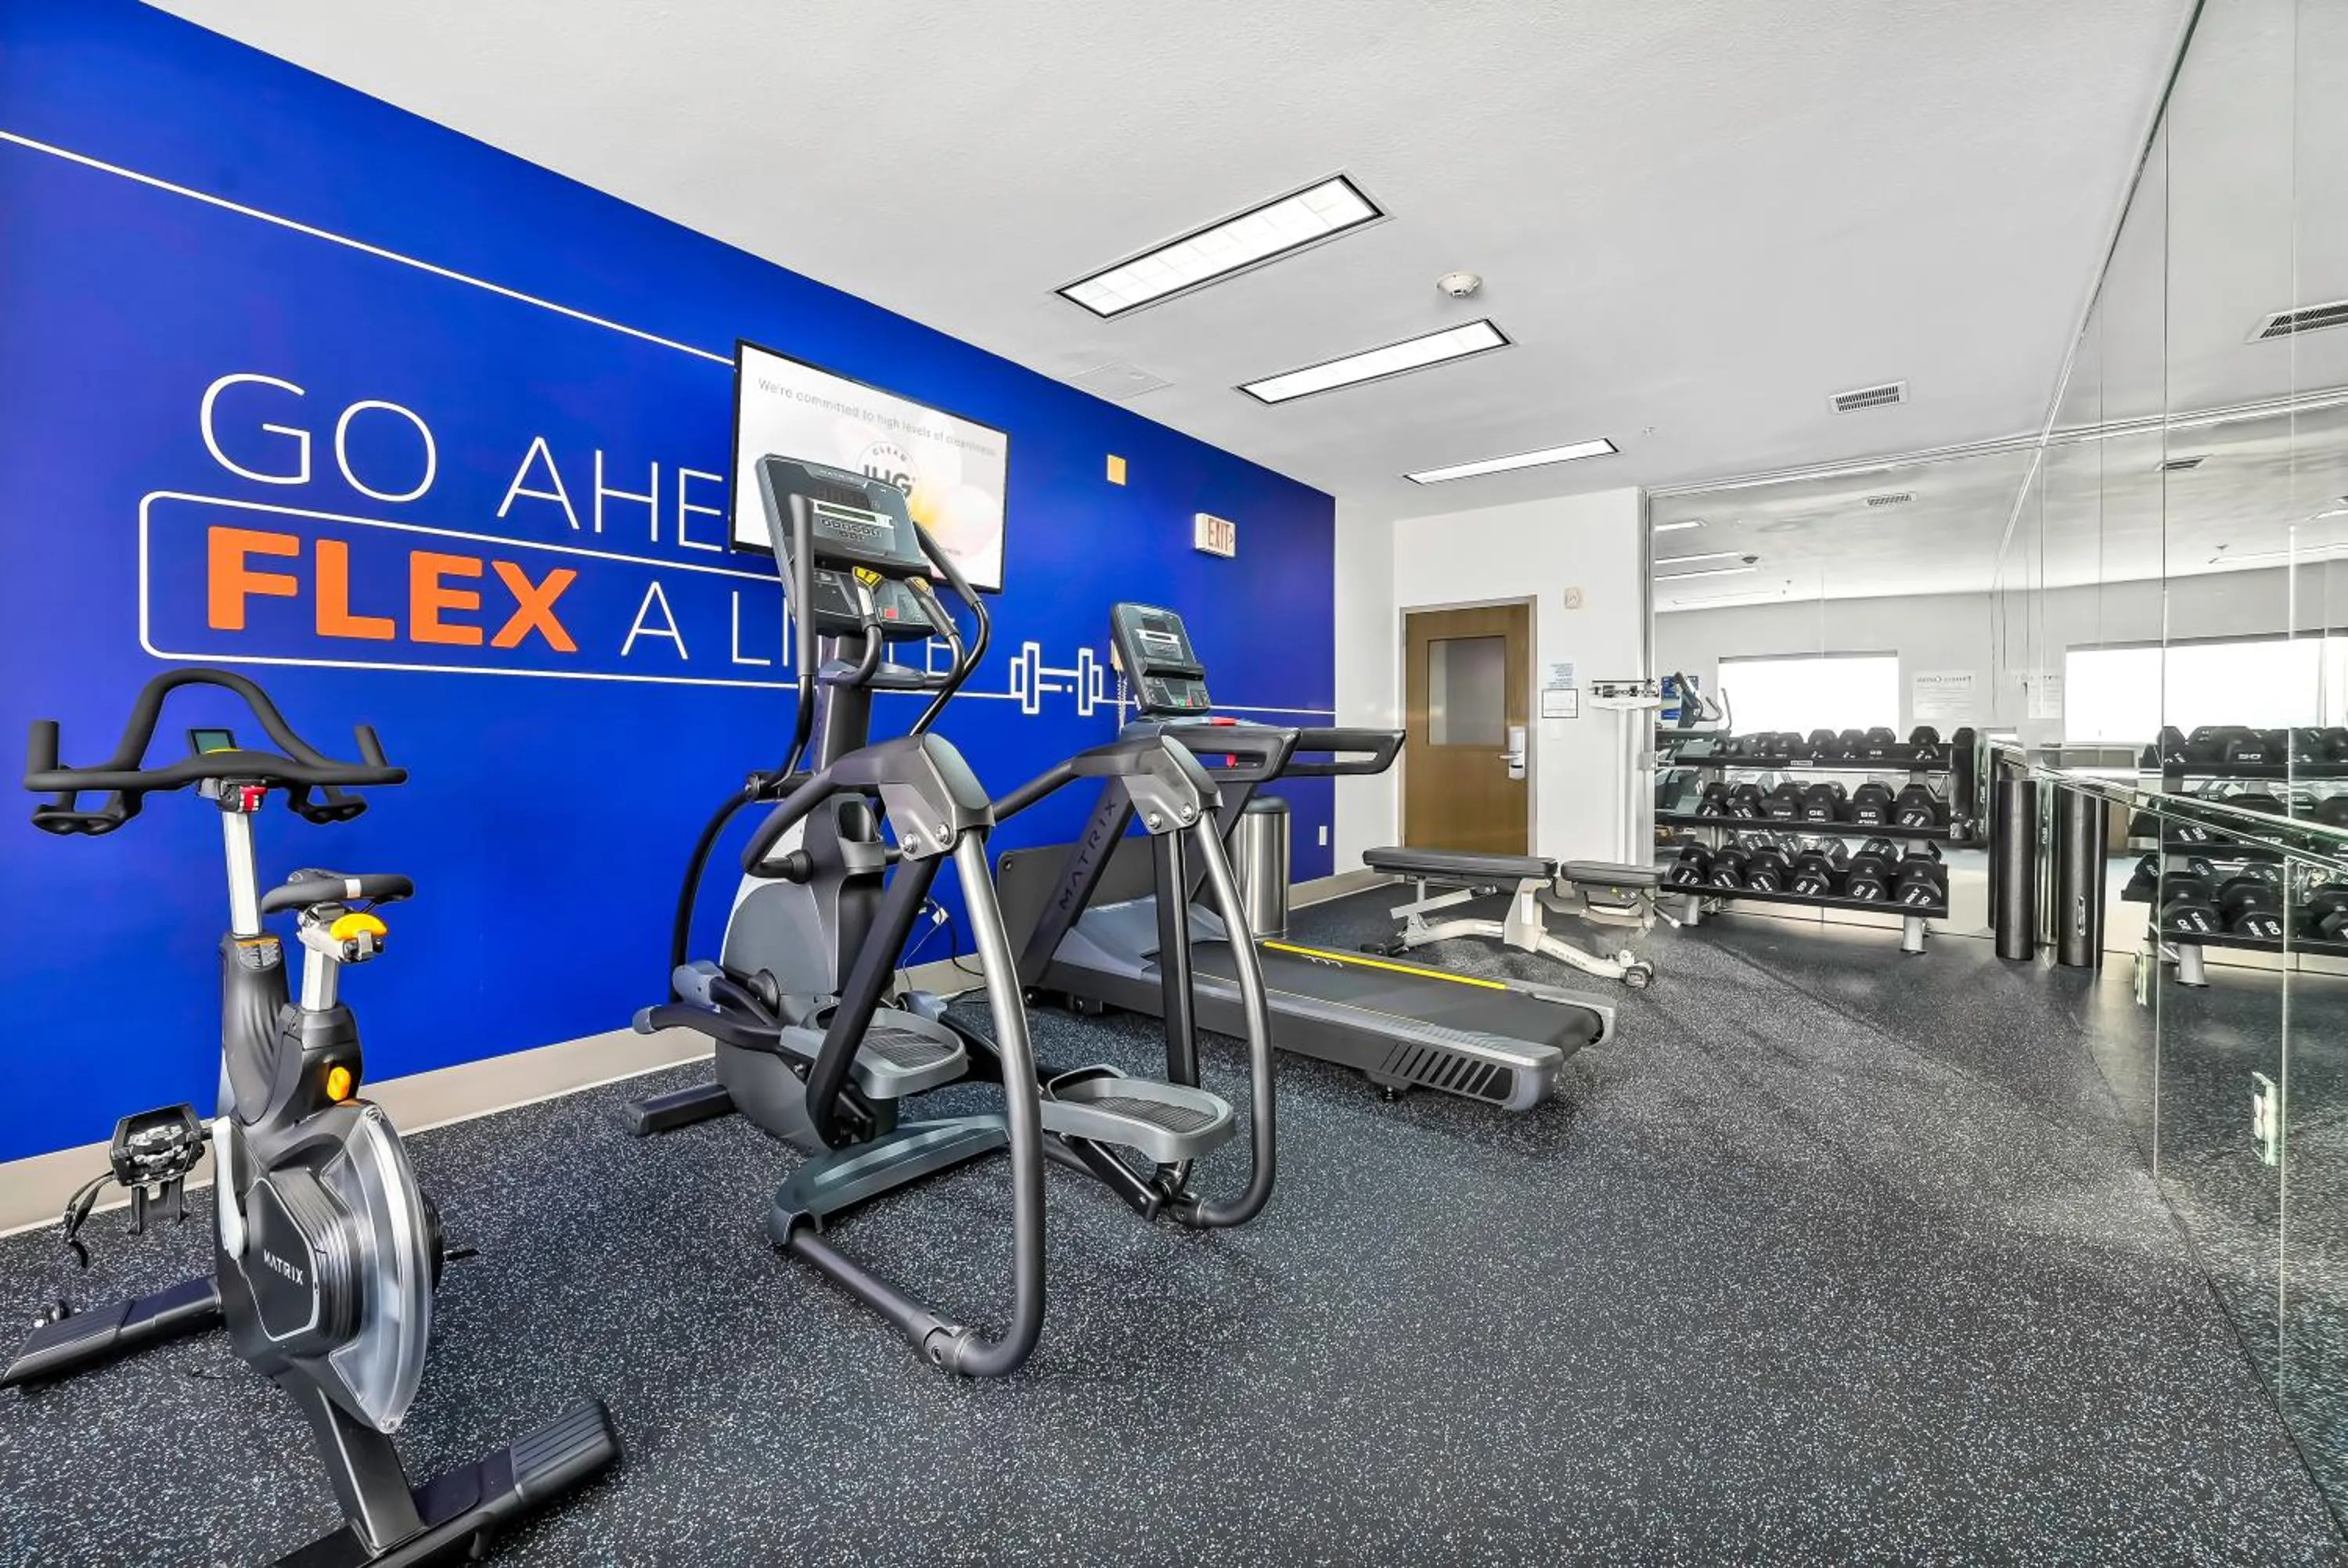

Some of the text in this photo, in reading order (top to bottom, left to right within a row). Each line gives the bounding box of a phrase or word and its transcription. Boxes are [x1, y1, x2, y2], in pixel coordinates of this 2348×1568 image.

[200, 373, 736, 554] GO AHE
[862, 409, 875, 423] to
[208, 526, 578, 652] FLEX
[621, 581, 689, 660] A
[1059, 798, 1116, 909] MATRIX
[263, 1248, 303, 1286] MATRIX
